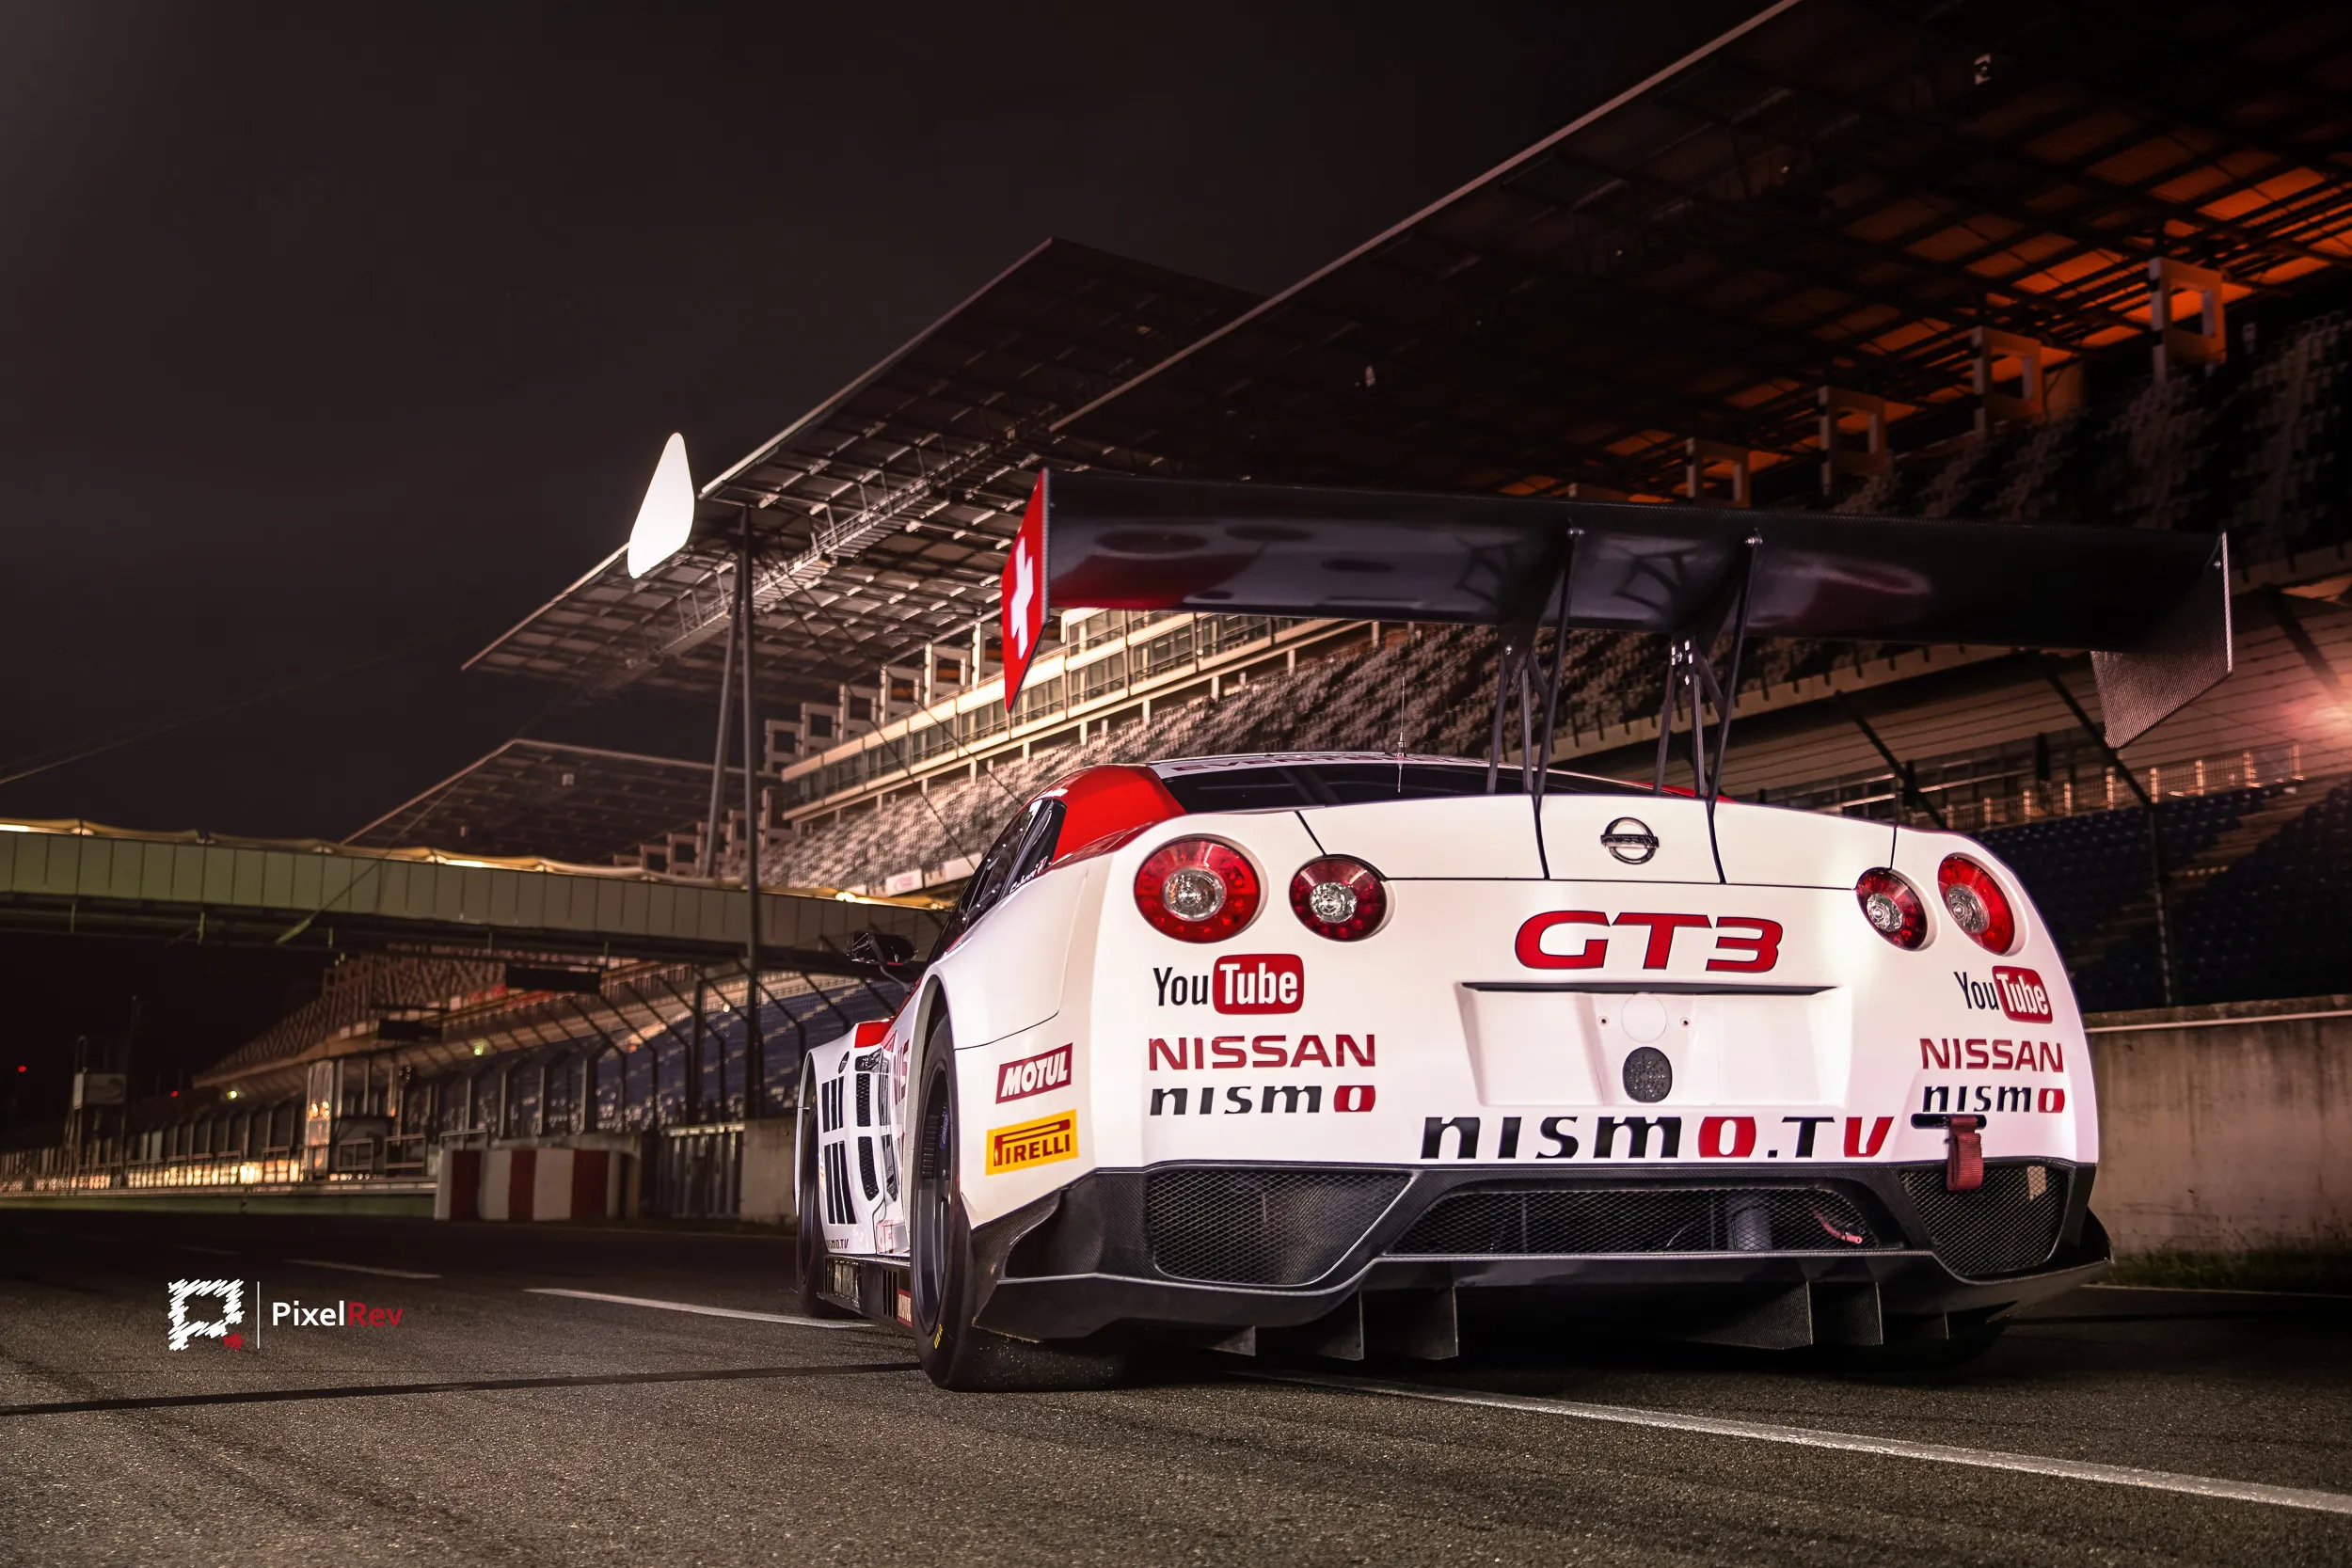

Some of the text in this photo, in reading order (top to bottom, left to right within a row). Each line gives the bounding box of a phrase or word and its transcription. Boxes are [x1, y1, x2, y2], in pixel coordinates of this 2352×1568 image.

[1515, 910, 1784, 974] GT3
[1152, 961, 1299, 1006] YouTube
[1149, 1034, 1375, 1071] NISSAN
[1919, 1037, 2064, 1073] NISSAN
[1000, 1051, 1068, 1098] MOTUL
[1150, 1085, 1376, 1117] nismo
[1922, 1085, 2065, 1114] nismo
[993, 1118, 1071, 1167] PIRELLI
